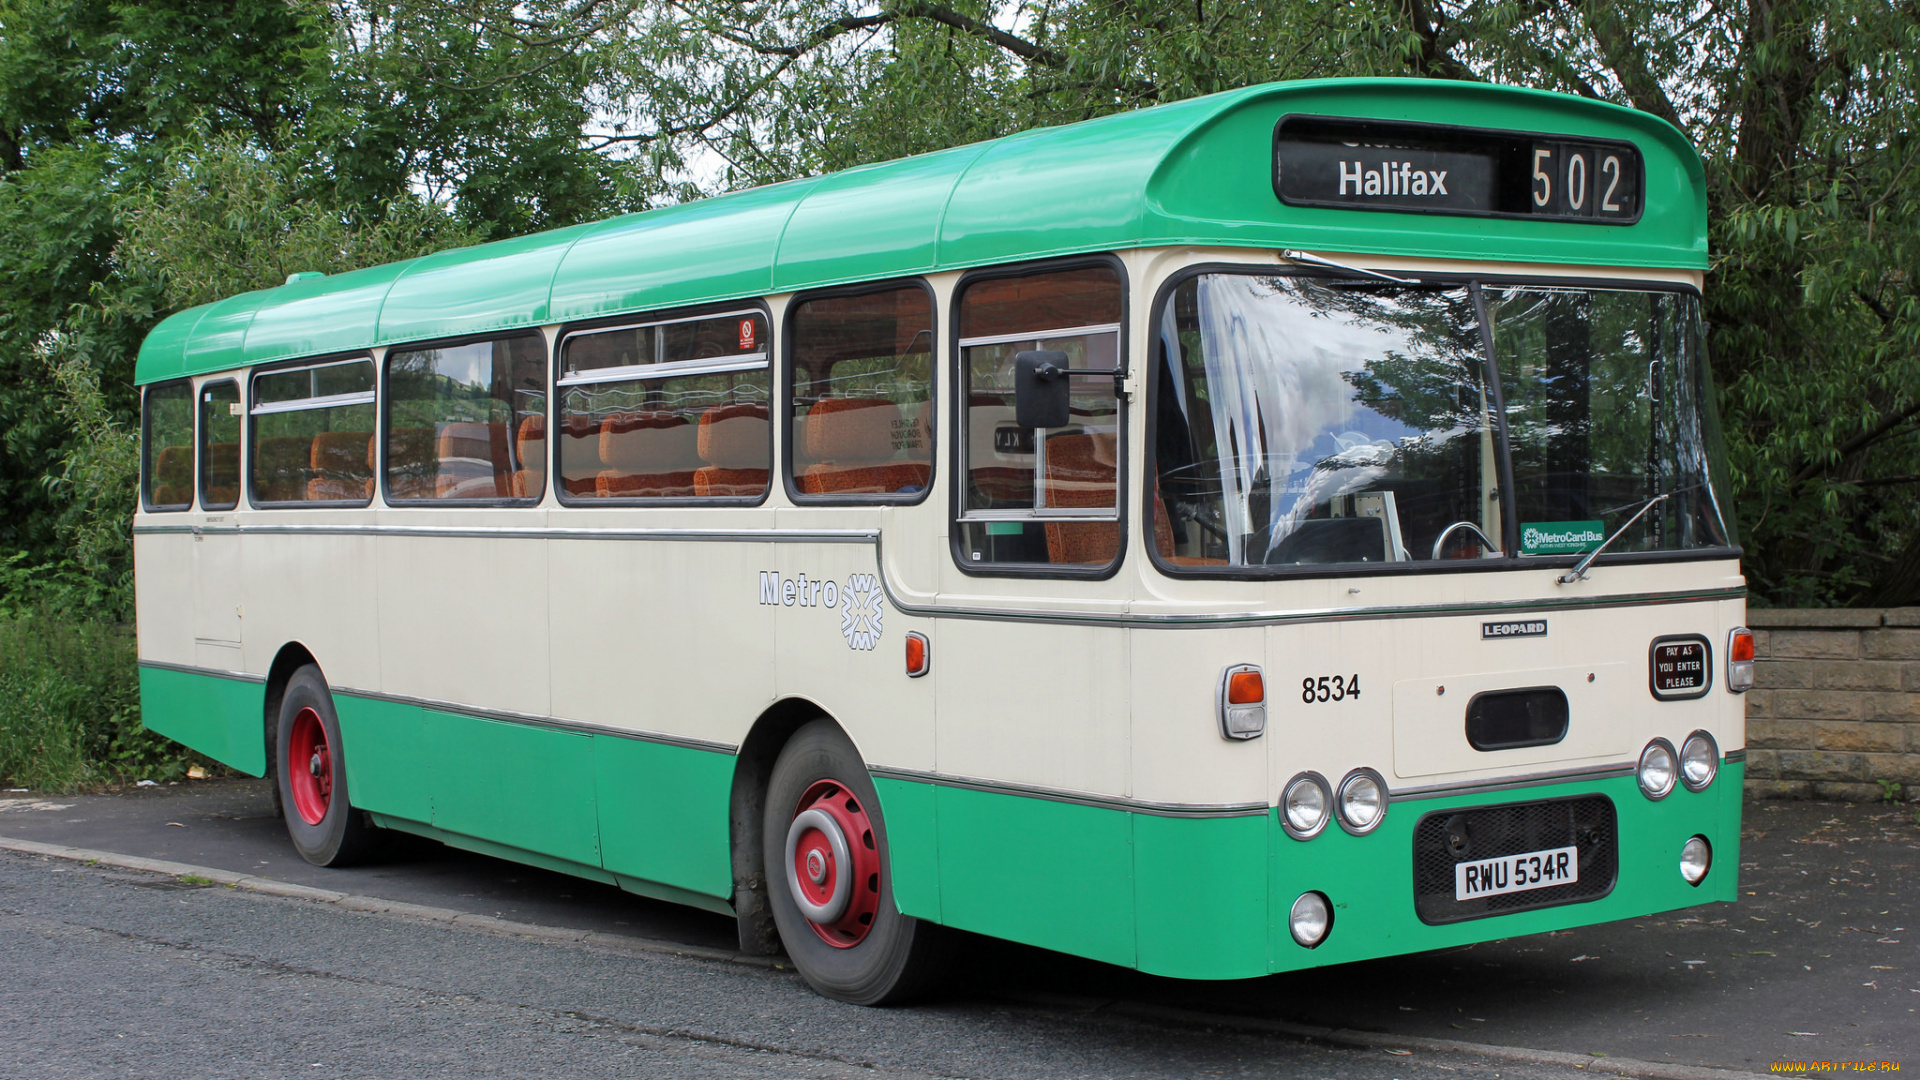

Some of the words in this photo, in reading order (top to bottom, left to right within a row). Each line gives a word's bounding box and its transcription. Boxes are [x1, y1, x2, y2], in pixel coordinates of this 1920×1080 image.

[1339, 161, 1448, 195] Halifax
[759, 571, 839, 608] Metro
[1484, 622, 1545, 636] LEOPARD
[1666, 647, 1678, 656] PAY
[1682, 646, 1693, 655] AS
[1659, 662, 1673, 672] YOU
[1677, 661, 1701, 671] ENTER
[1302, 674, 1361, 703] 8534
[1666, 677, 1694, 687] PLEASE
[1465, 861, 1508, 893] RWU
[1515, 852, 1570, 885] 534R
